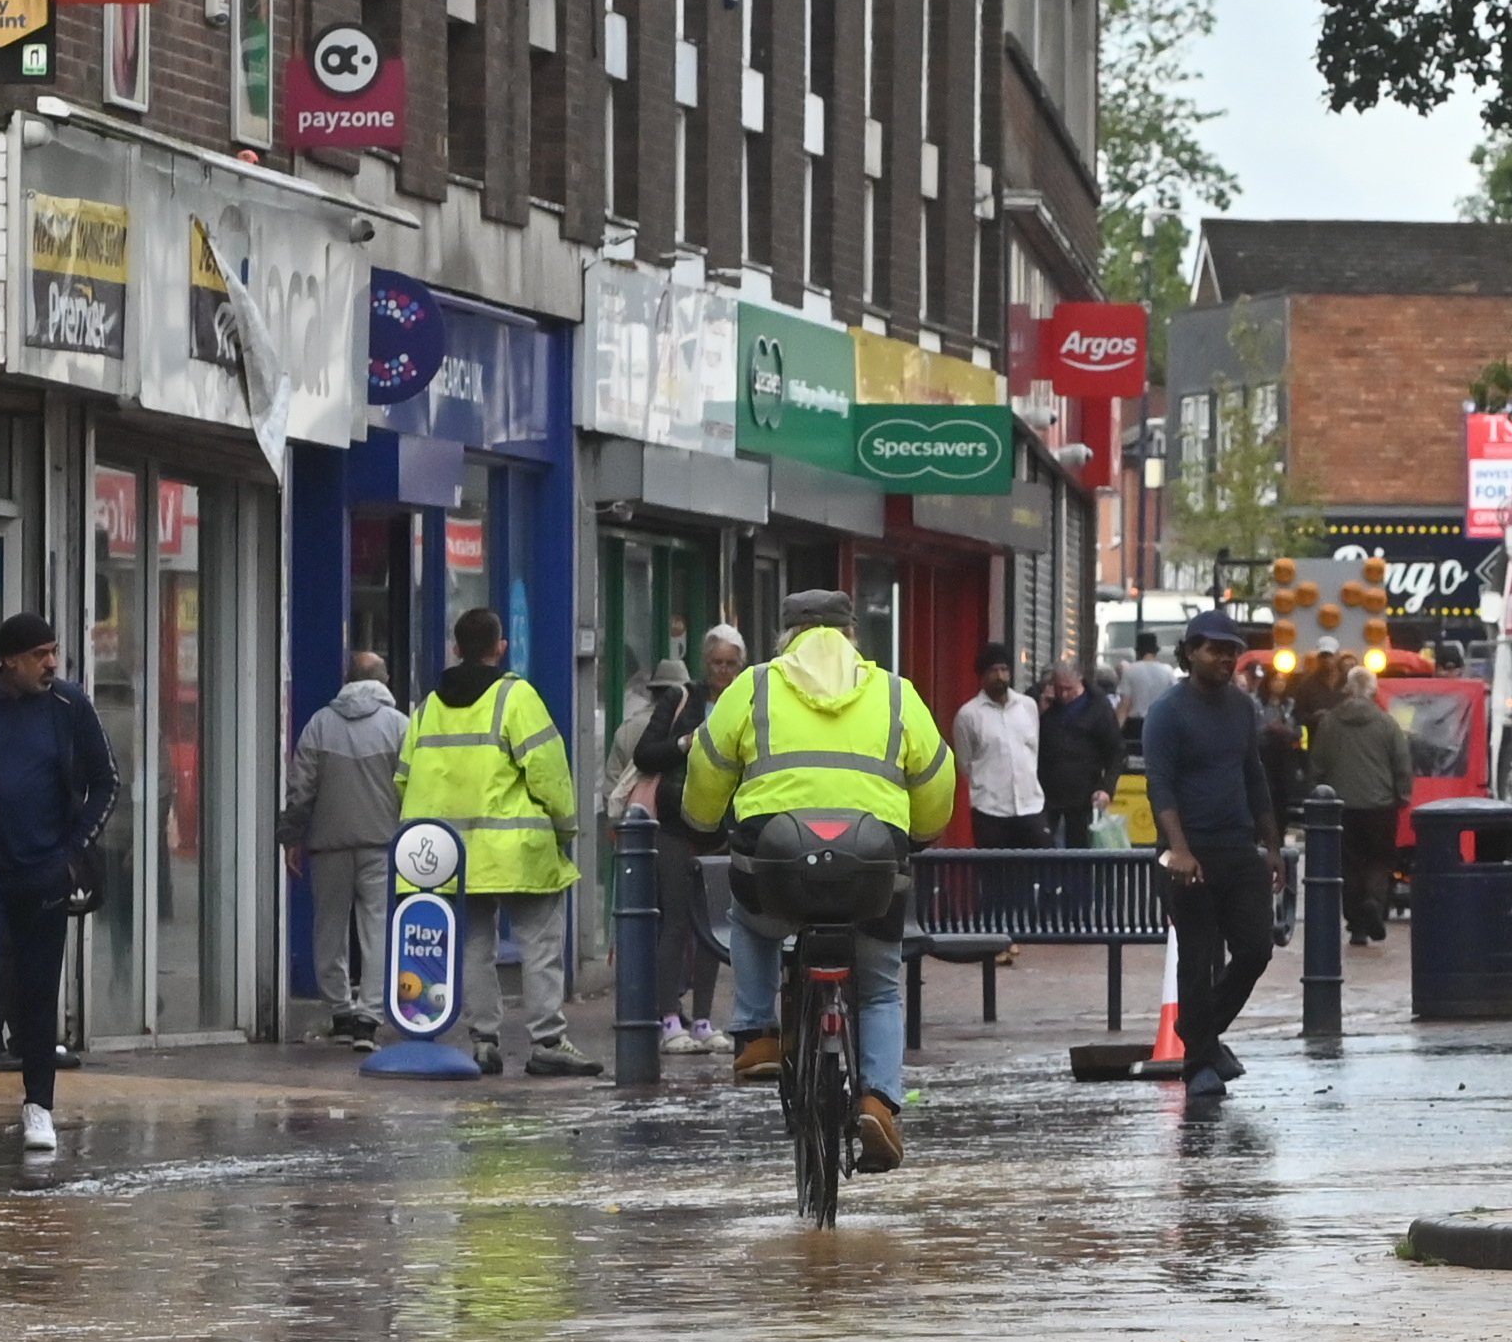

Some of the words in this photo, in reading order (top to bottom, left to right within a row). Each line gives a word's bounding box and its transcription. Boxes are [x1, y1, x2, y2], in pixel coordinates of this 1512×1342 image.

[298, 110, 395, 134] payzone
[1059, 330, 1138, 361] Argos
[872, 437, 988, 459] Specsavers
[404, 923, 443, 945] Play
[403, 941, 443, 958] here
